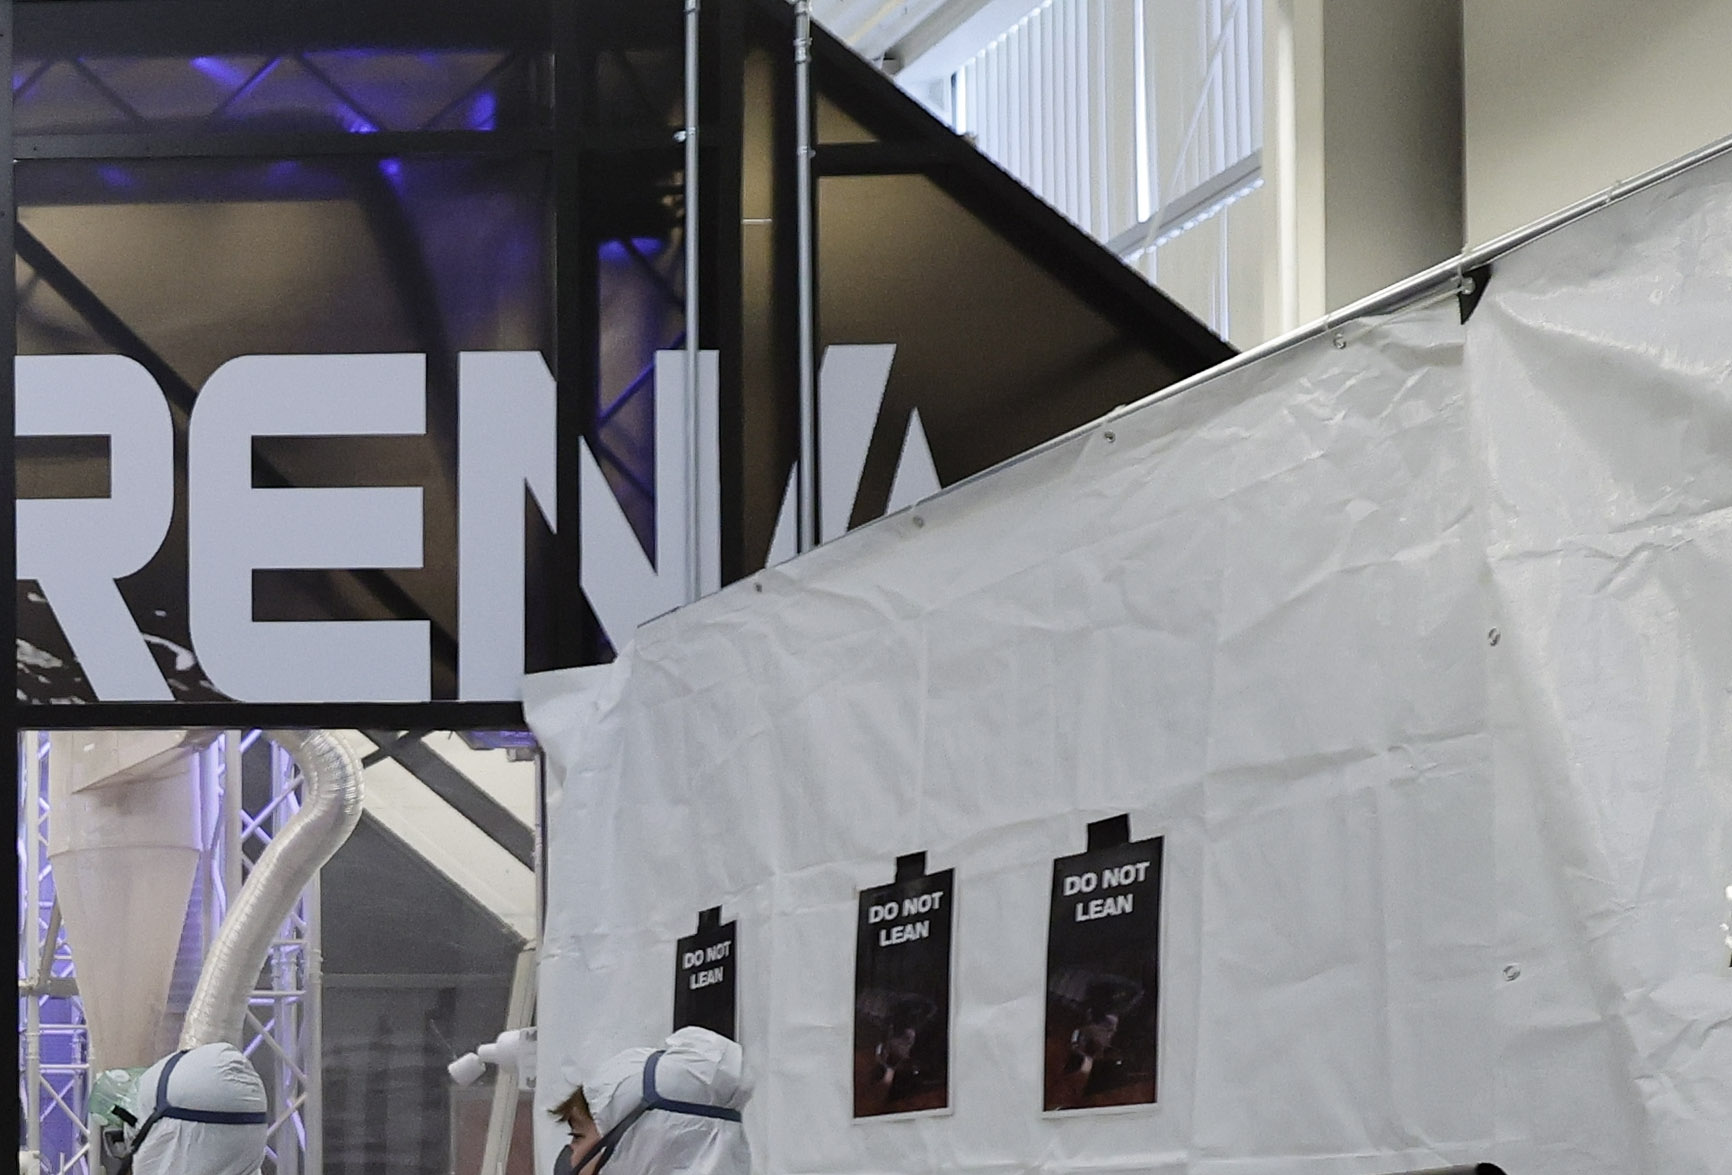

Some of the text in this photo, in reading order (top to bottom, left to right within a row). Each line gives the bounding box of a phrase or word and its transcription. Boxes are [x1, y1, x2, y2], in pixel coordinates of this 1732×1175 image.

[1064, 861, 1151, 896] DO NOT
[868, 891, 944, 924] DO NOT
[1075, 893, 1134, 922] LEAN
[879, 920, 930, 947] LEAN
[682, 940, 732, 971] DO NOT
[689, 966, 724, 990] LEAN
